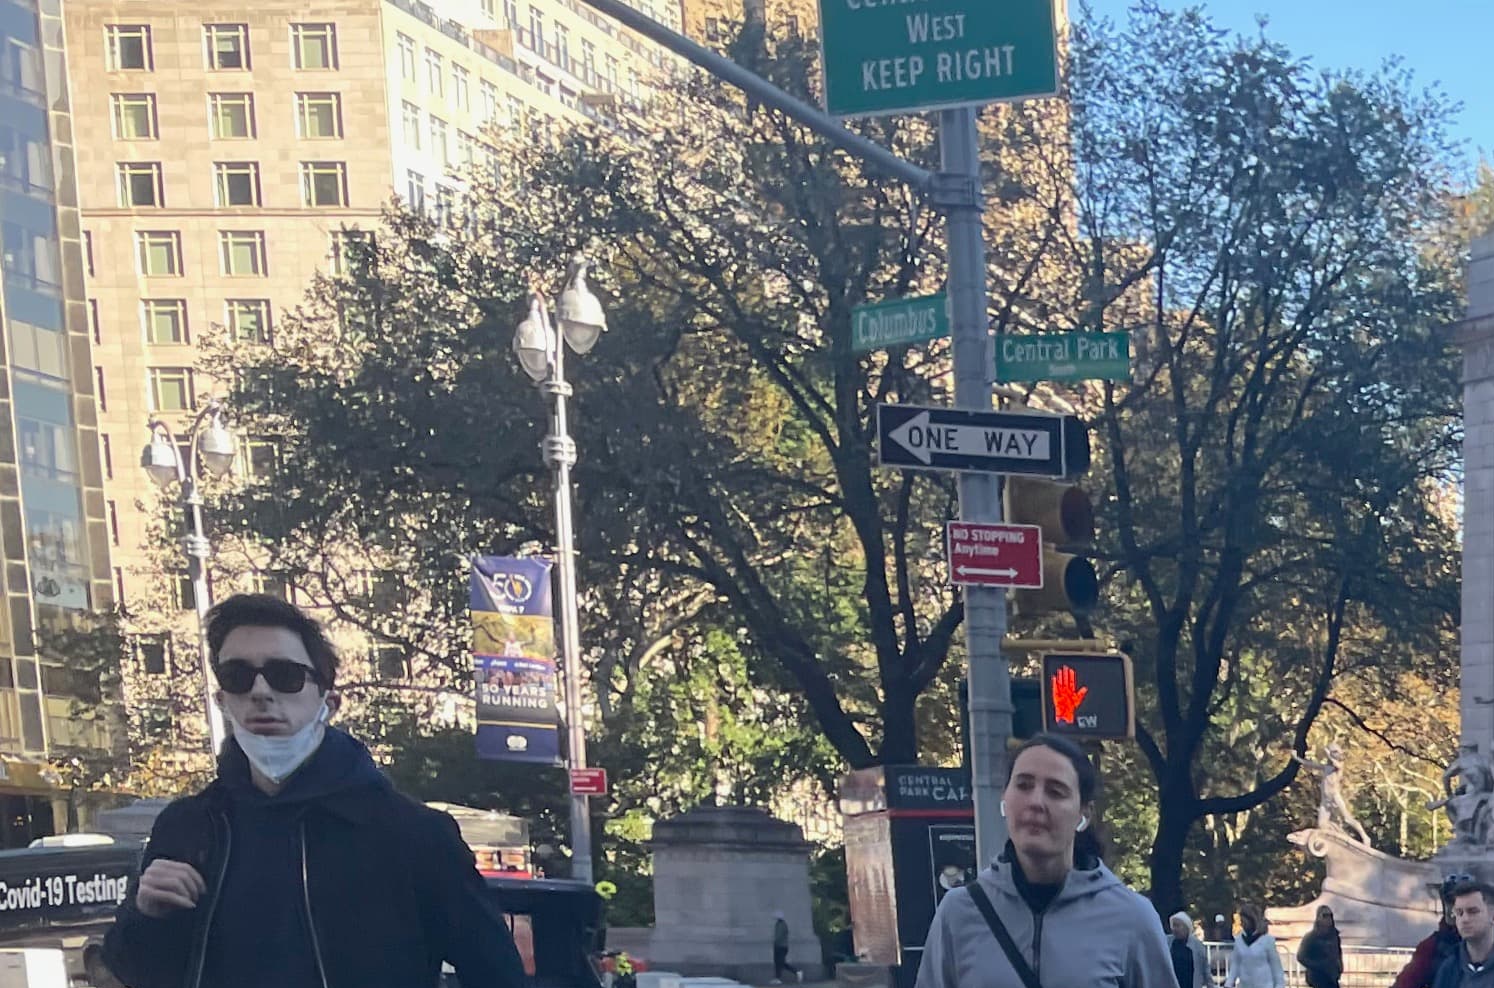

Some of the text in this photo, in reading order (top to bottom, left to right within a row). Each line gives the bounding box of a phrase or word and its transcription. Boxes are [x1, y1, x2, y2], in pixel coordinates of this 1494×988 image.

[906, 13, 965, 43] WEST
[862, 45, 1015, 91] KEEP RIGHT
[859, 305, 937, 344] Columbus
[1003, 338, 1119, 361] Central Park
[909, 426, 1038, 456] ONE WAY
[952, 528, 1025, 544] NO STOPPING
[954, 542, 999, 558] Anytime
[503, 684, 547, 697] YEARS
[482, 694, 548, 709] RUNNING
[898, 775, 952, 785] CENTRAL
[899, 787, 969, 801] PARK CAF
[0, 874, 128, 911] Covid-19 Testing
